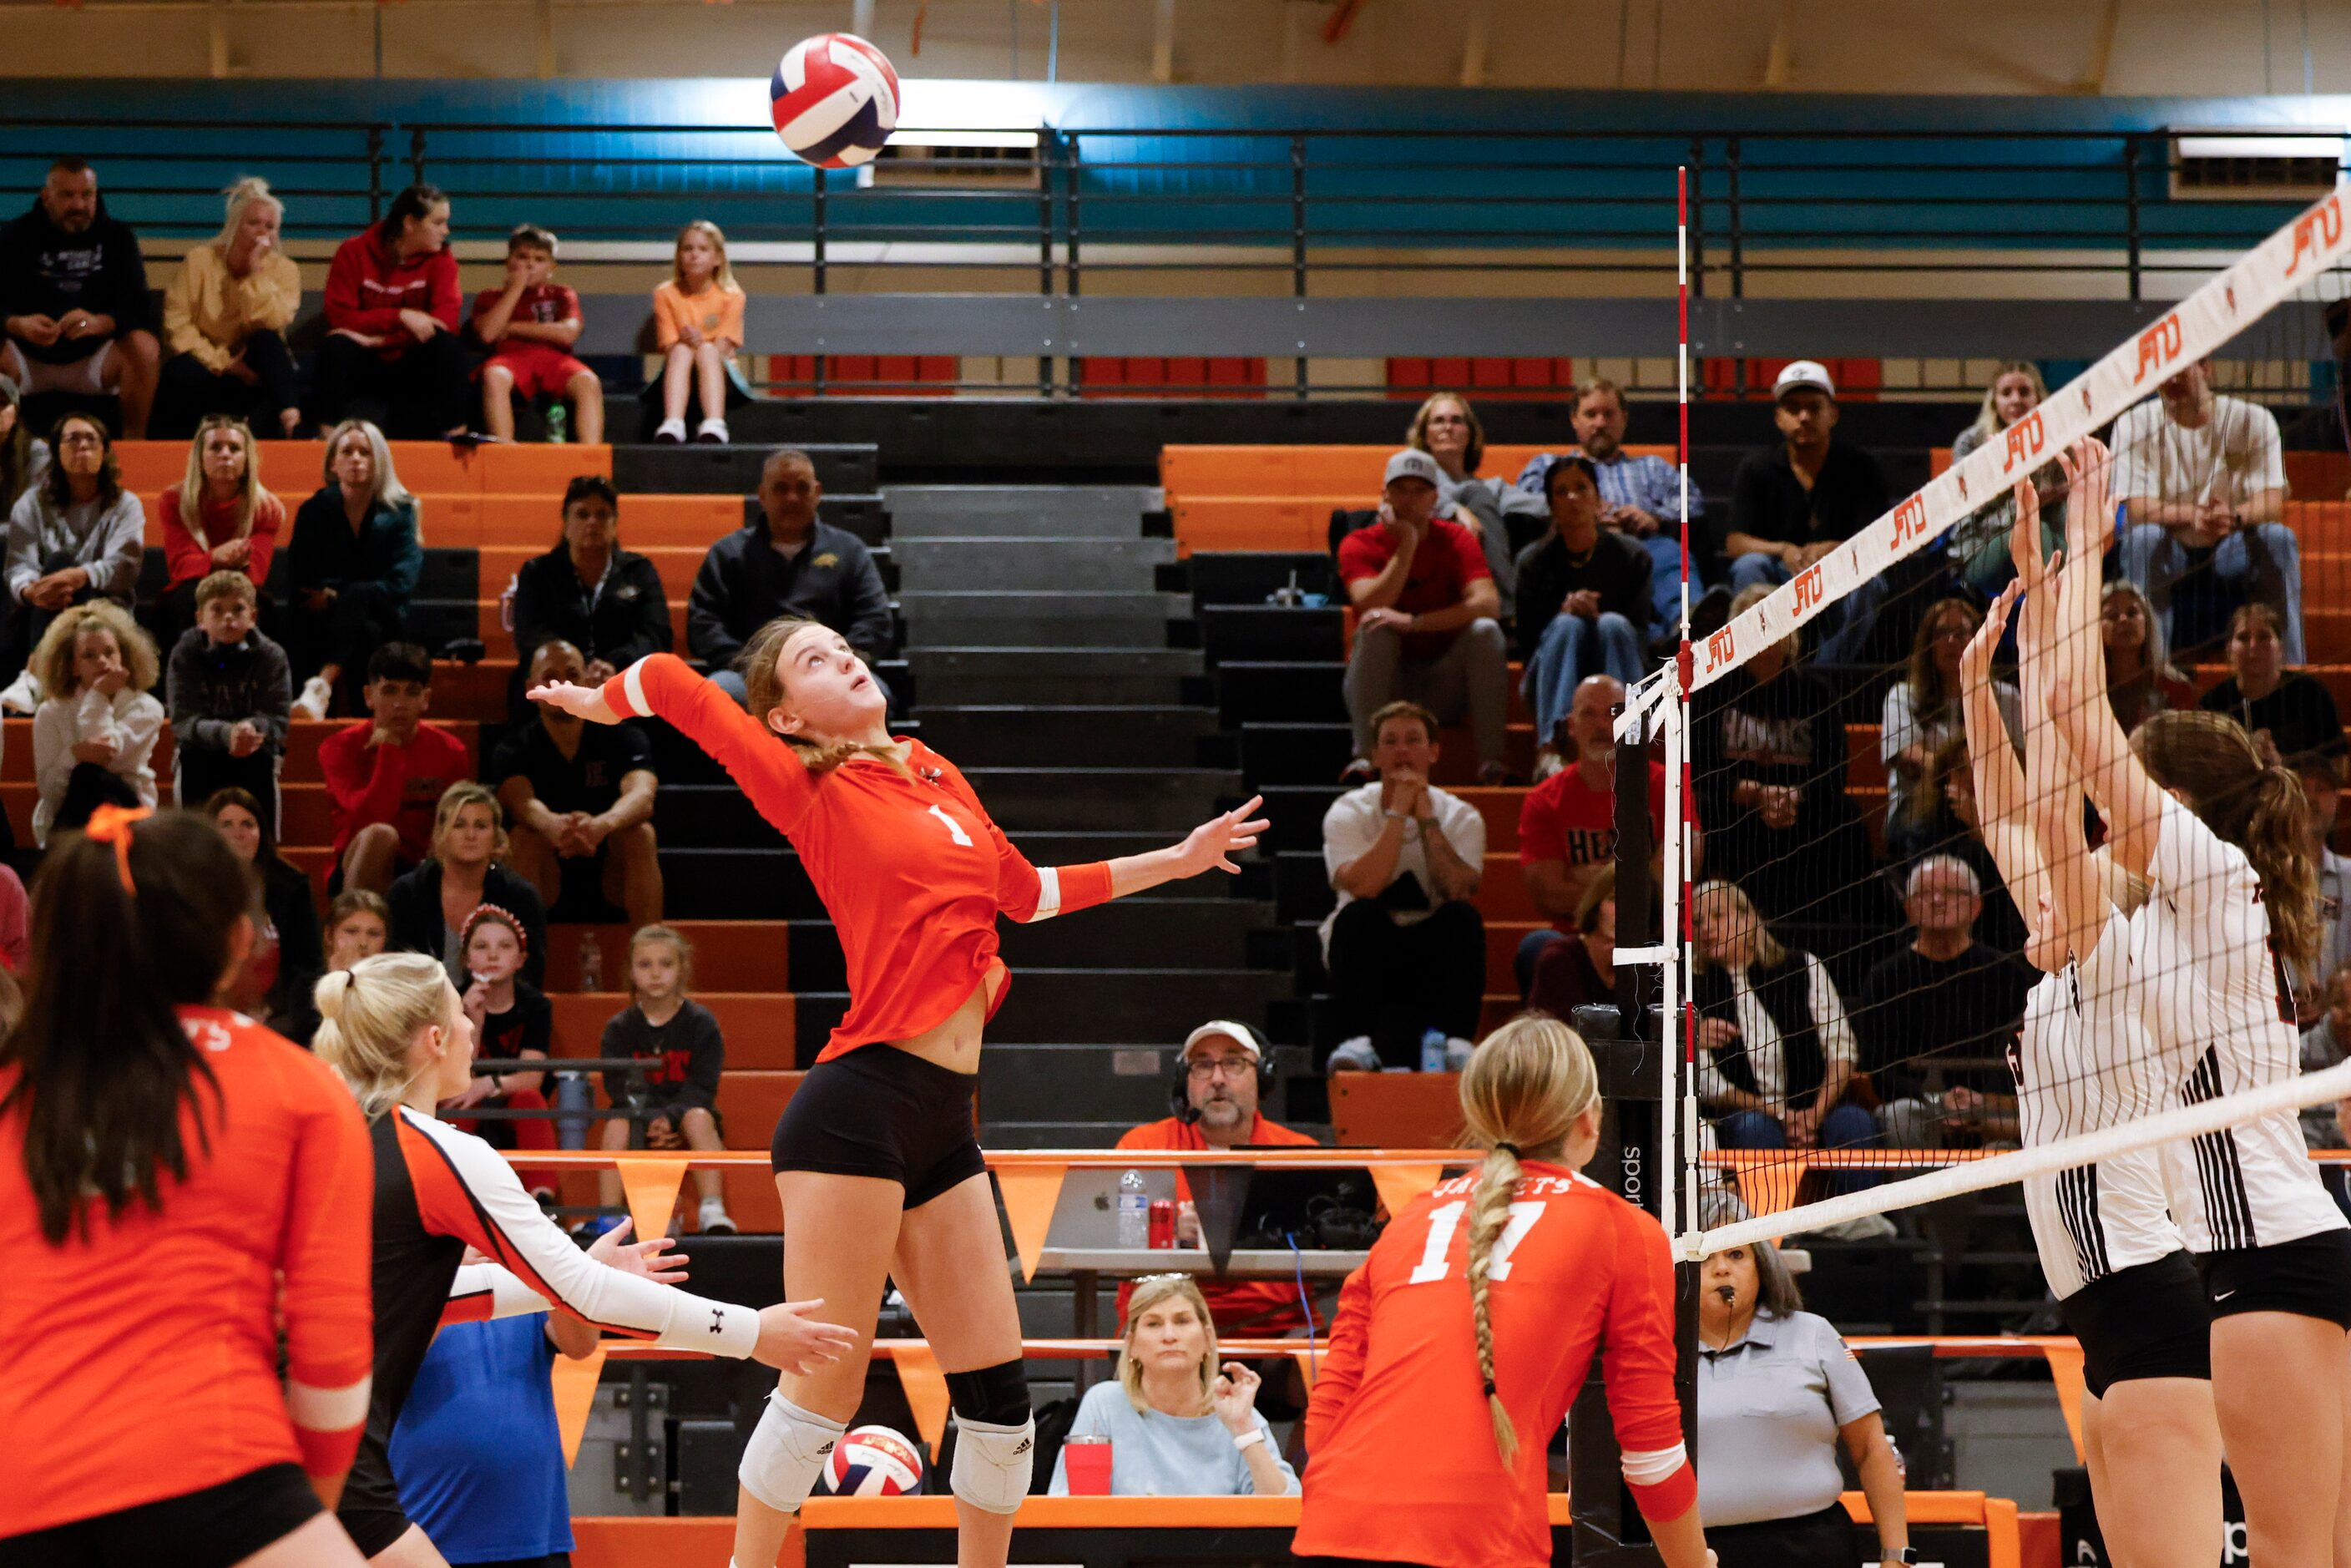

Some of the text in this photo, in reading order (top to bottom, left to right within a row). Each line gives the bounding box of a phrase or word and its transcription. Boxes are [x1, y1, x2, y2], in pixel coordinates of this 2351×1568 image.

[928, 803, 974, 847] 1
[1432, 1176, 1572, 1199] JAETS
[1409, 1201, 1547, 1284] 17
